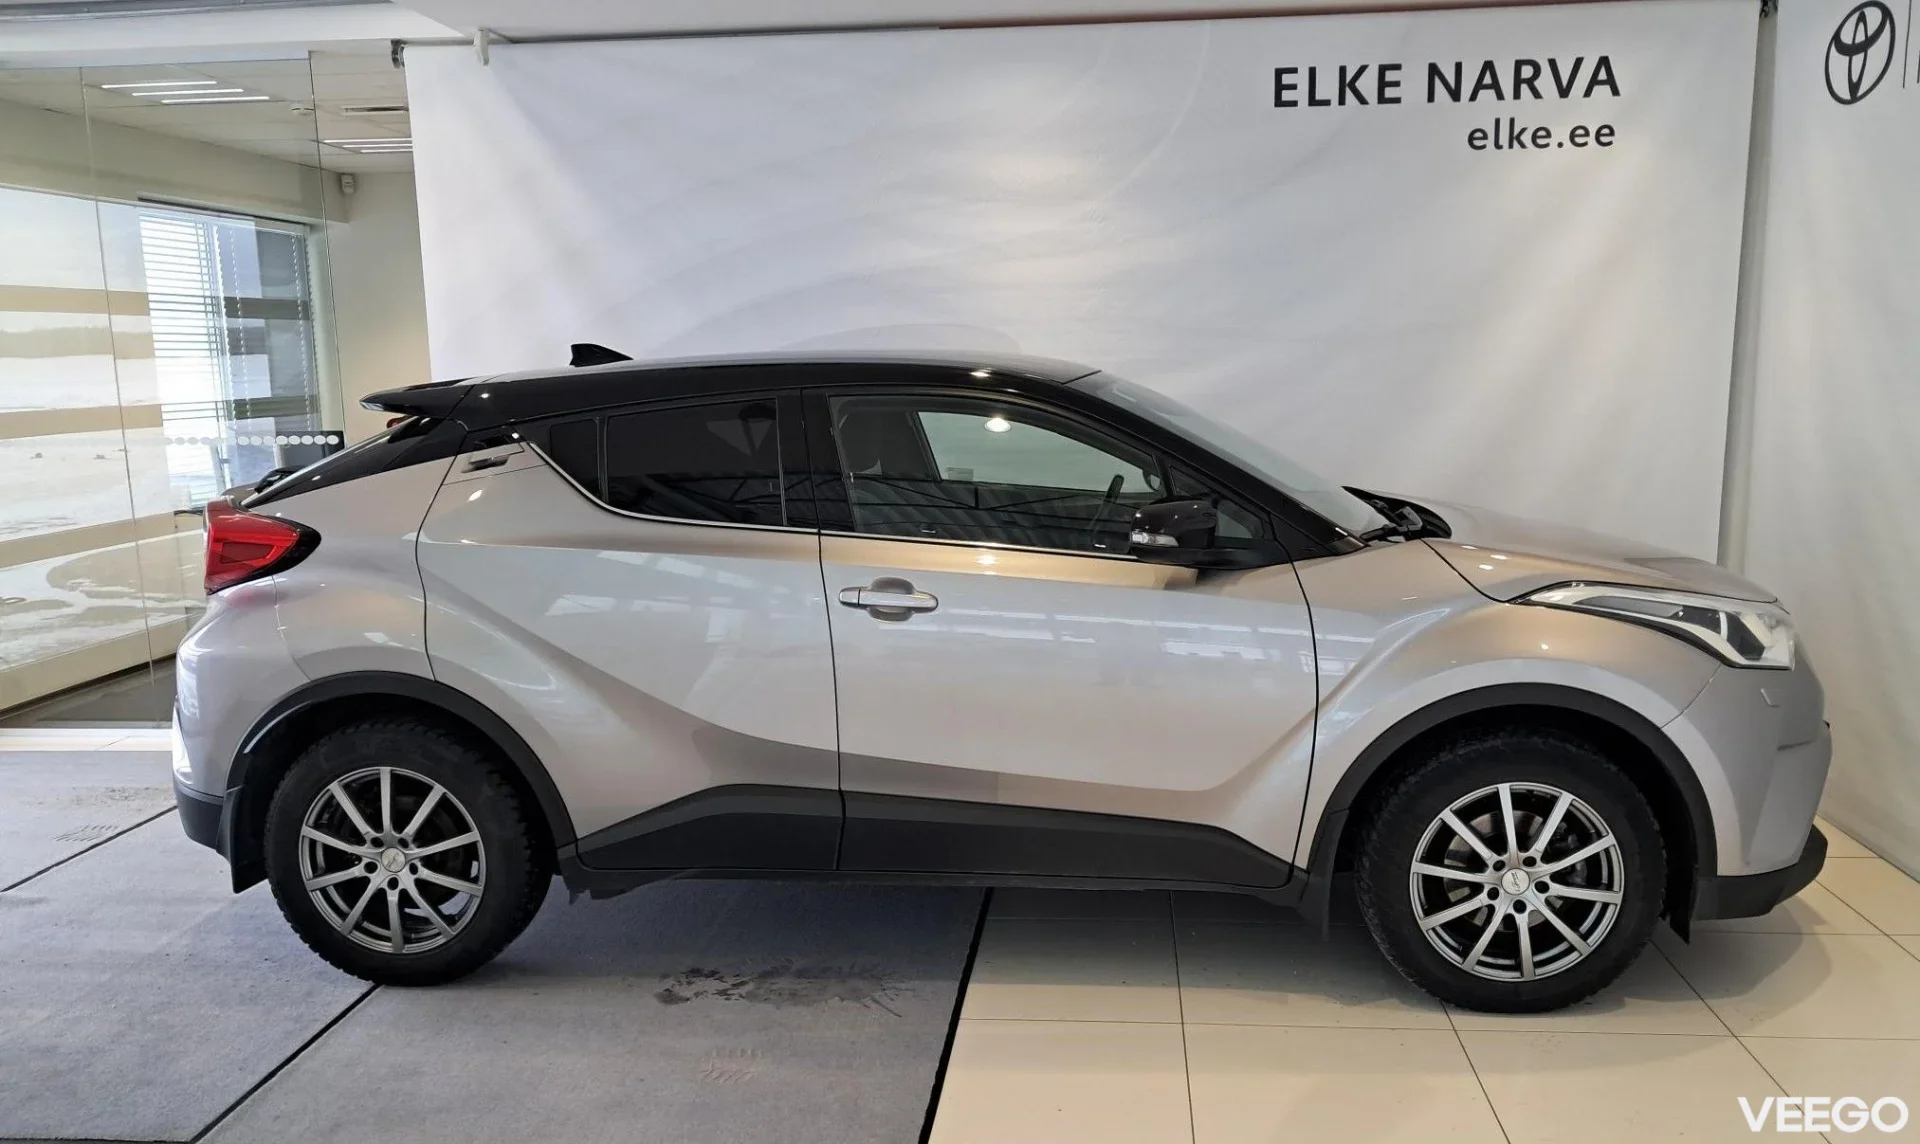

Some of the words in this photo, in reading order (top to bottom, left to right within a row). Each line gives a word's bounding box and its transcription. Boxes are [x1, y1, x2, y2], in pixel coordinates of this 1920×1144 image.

[1273, 62, 1403, 108] ELKE
[1426, 55, 1621, 104] NARVA
[1467, 117, 1616, 151] elke.ee
